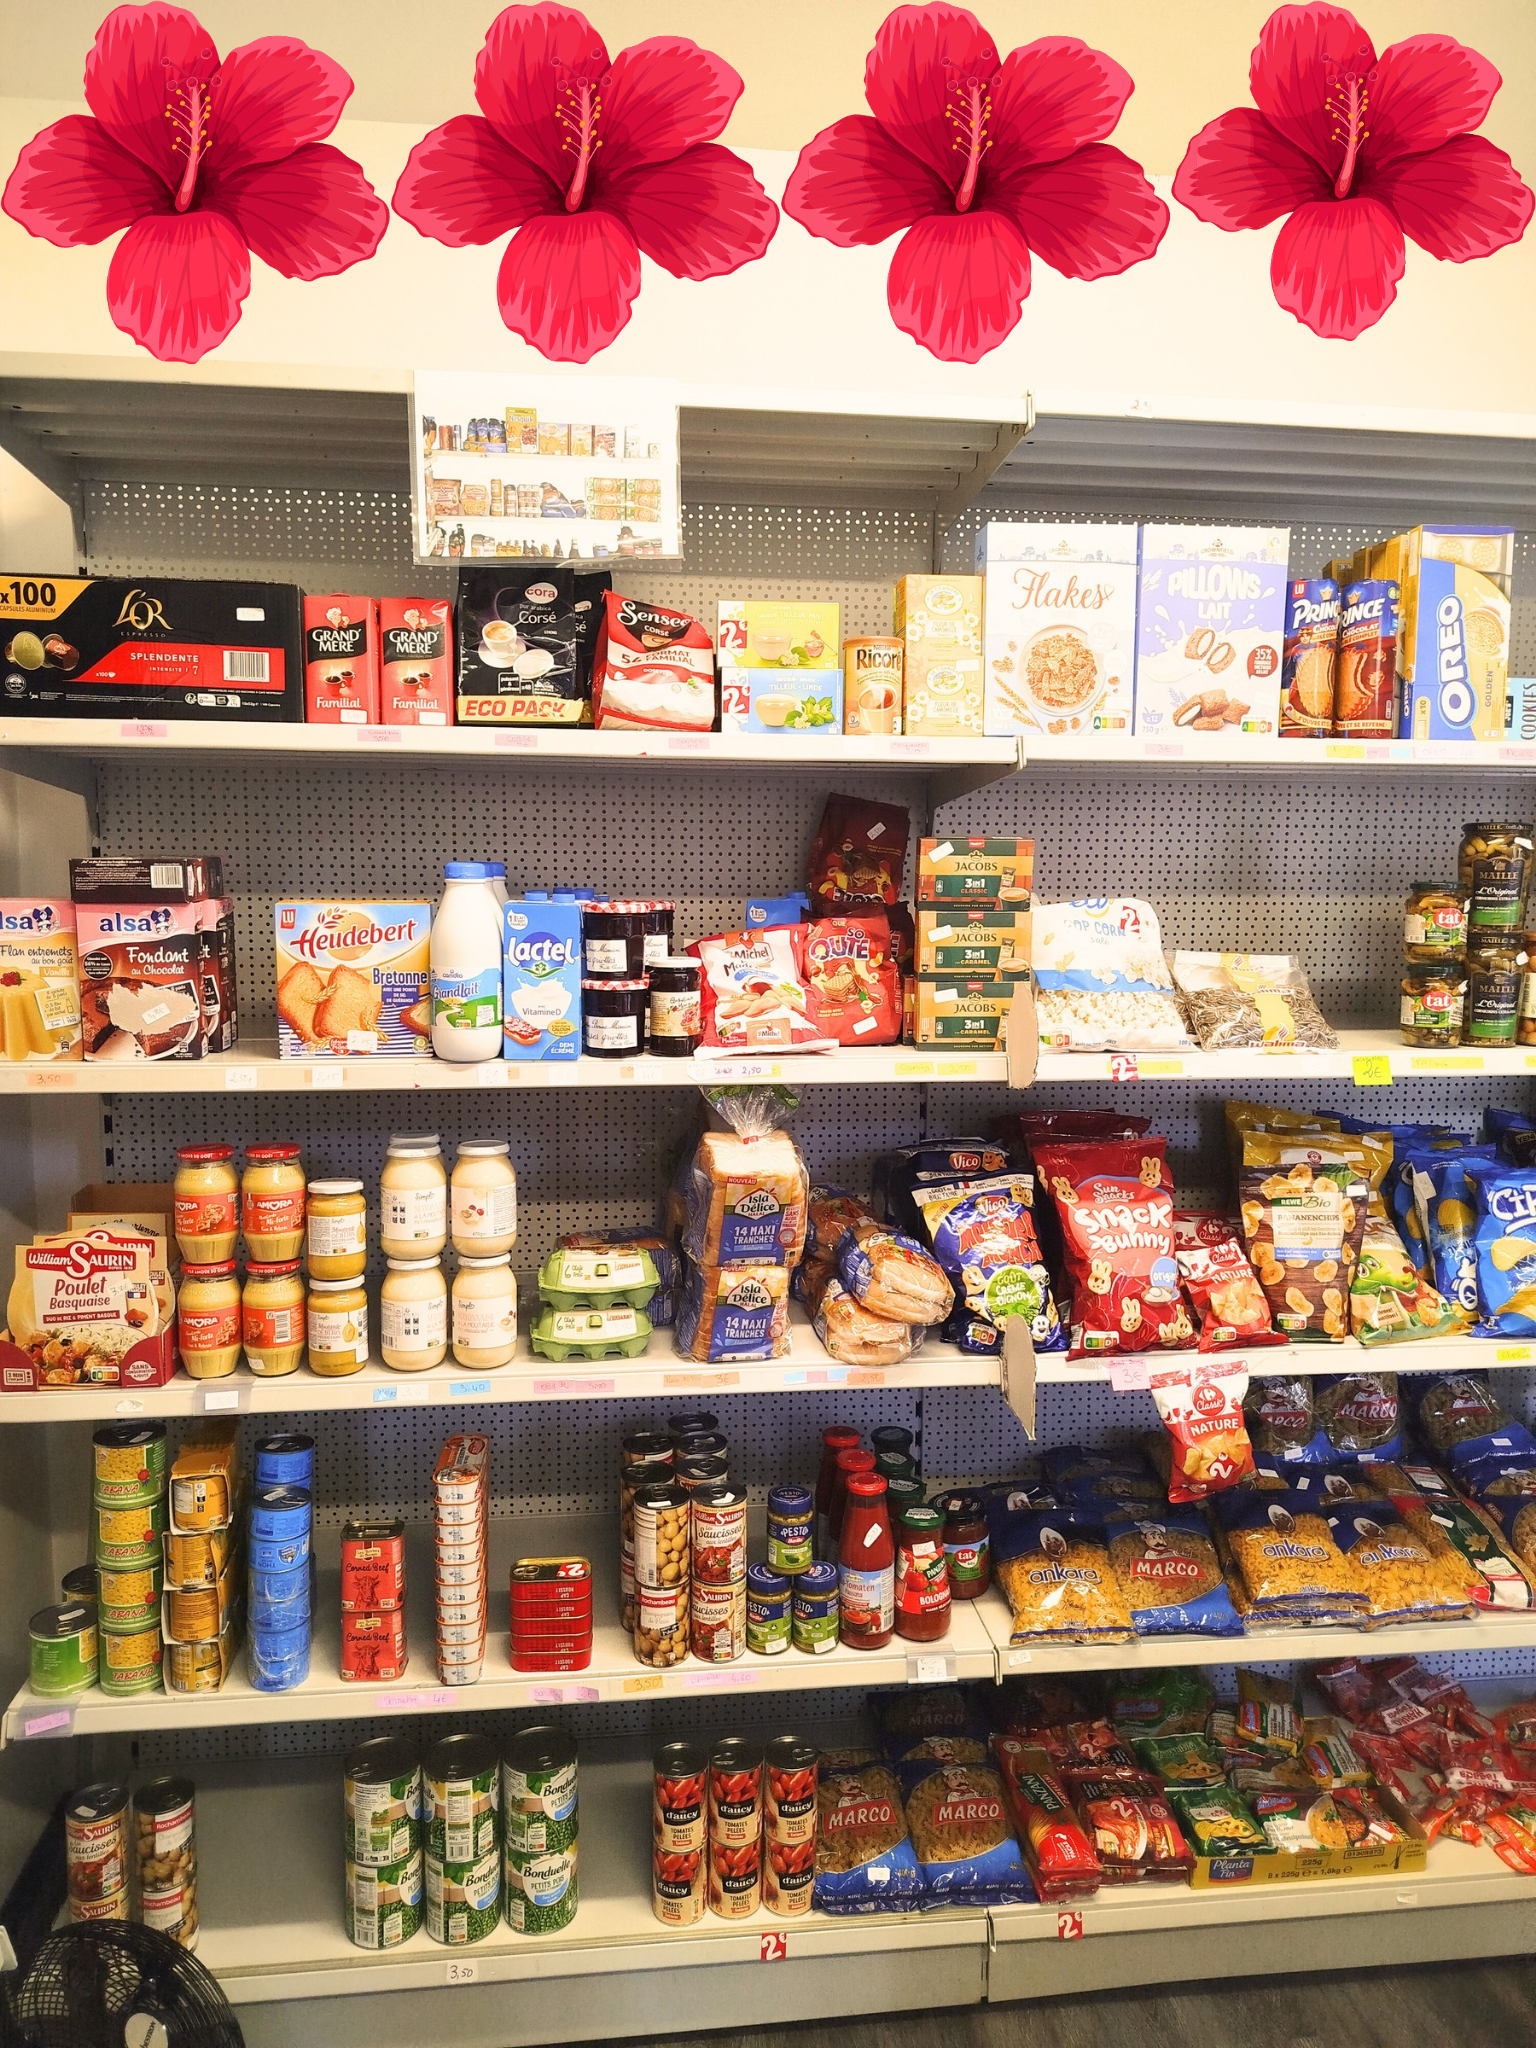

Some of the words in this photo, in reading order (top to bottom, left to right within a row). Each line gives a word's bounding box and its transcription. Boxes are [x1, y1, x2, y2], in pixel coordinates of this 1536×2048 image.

[1168, 564, 1262, 600] PILLOWS
[526, 587, 556, 599] cora
[1011, 567, 1104, 610] Flakes
[1295, 584, 1305, 595] LU
[616, 600, 692, 627] Senseo
[1198, 602, 1232, 620] LAIT
[519, 611, 557, 624] Corsé
[644, 625, 670, 637] CORSÉ
[130, 652, 199, 663] SPLENDENTE
[856, 649, 902, 670] Ricoré
[1254, 648, 1272, 660] 35%
[1439, 596, 1471, 723] OREO
[646, 654, 695, 667] FAMILIAL
[192, 665, 199, 675] 7
[802, 684, 824, 692] LINDE
[1485, 671, 1493, 707] GOLDEN
[316, 697, 361, 708] Familial
[393, 698, 439, 709] Familial
[464, 699, 506, 716] ECO
[511, 700, 566, 718] PACK
[954, 862, 998, 872] JACOBS
[1479, 871, 1519, 880] MAILLE
[100, 913, 152, 932] alsa
[283, 911, 294, 923] LU
[1437, 912, 1462, 925] tat
[847, 927, 865, 939] SO
[1095, 922, 1126, 936] CORN
[290, 920, 418, 958] Heudebert
[954, 933, 997, 943] JACOBS
[0, 945, 25, 957] Flan
[28, 946, 73, 957] entremets
[126, 947, 190, 963] Fondant
[508, 937, 575, 966] lactel
[734, 947, 770, 960] Michel
[43, 968, 70, 976] Vanille
[143, 964, 185, 975] Chocolat
[372, 967, 428, 984] Bretonne
[1479, 985, 1517, 994] MAILLE
[1425, 995, 1452, 1008] tat
[954, 1003, 997, 1013] JACOBS
[742, 1066, 761, 1075] 2,50
[1112, 1055, 1137, 1081] 2€
[1363, 1060, 1382, 1078] 2€
[36, 1075, 61, 1085] 3,50
[953, 1156, 979, 1169] Vico
[1093, 1183, 1120, 1195] Sun
[748, 1193, 769, 1204] Isla
[1093, 1190, 1135, 1204] Snacks
[1303, 1196, 1331, 1208] Bio
[256, 1199, 293, 1210] AMORA
[740, 1203, 776, 1213] Délice
[979, 1198, 1005, 1213] Vico
[1074, 1202, 1171, 1234] Snack
[734, 1226, 748, 1236] 14
[750, 1225, 776, 1236] MAXI
[734, 1235, 775, 1245] TRANCHES
[1097, 1231, 1170, 1255] Bunny
[28, 1253, 72, 1266] William
[66, 1243, 133, 1278] SAURIN
[1211, 1251, 1238, 1263] Classic
[997, 1272, 1022, 1284] GOÛT
[1210, 1267, 1254, 1284] NATURE
[54, 1277, 107, 1296] Poulet
[740, 1283, 761, 1295] Isla
[996, 1282, 1026, 1295] CRÈME
[50, 1295, 110, 1311] Basquaise
[732, 1293, 767, 1304] Délice
[996, 1291, 1032, 1306] OIGNON
[183, 1317, 218, 1328] AMORA
[726, 1317, 739, 1328] 14
[741, 1317, 767, 1328] MAXI
[725, 1328, 765, 1338] TRANCHES
[1123, 1368, 1141, 1384] 3€
[460, 1383, 486, 1393] 3,40
[1196, 1400, 1223, 1413] Classic
[1341, 1402, 1398, 1418] MARCO
[1190, 1418, 1239, 1436] NATURE
[101, 1483, 139, 1494] TABANA
[715, 1509, 744, 1525] SAURIN
[699, 1526, 742, 1538] Saucisses
[782, 1526, 808, 1537] PESTO
[105, 1545, 144, 1556] TABANA
[958, 1550, 973, 1560] tat
[1263, 1540, 1325, 1560] ankara
[1360, 1545, 1423, 1565] ankara
[346, 1562, 371, 1572] Corned
[372, 1562, 389, 1573] Beef
[1137, 1560, 1198, 1577] MARCO
[1029, 1563, 1099, 1585] ankara
[700, 1590, 732, 1602] SAURIN
[844, 1589, 863, 1598] Passata
[107, 1607, 146, 1618] TABANA
[346, 1632, 372, 1642] Corned
[373, 1632, 389, 1643] Beef
[113, 1667, 154, 1680] TABANA
[634, 1678, 660, 1690] 3,50
[1022, 1775, 1060, 1810] PANZANI
[720, 1804, 753, 1815] d'aucy
[781, 1801, 812, 1812] d'aucy
[938, 1803, 999, 1820] MARCO
[156, 1810, 192, 1829] Rochambeau
[666, 1810, 699, 1821] d'aucy
[829, 1807, 890, 1829] MARCO
[786, 1818, 808, 1826] TOMATES
[788, 1824, 806, 1832] PELÉES
[84, 1820, 121, 1842] SAURIN
[671, 1827, 694, 1835] TOMATES
[672, 1832, 692, 1840] PELÉES
[727, 1826, 745, 1834] PELÉES
[69, 1835, 117, 1853] Saucisses
[1212, 1860, 1250, 1871] Planta
[1302, 1858, 1322, 1866] 225g
[523, 1859, 570, 1880] Bonduelle
[1220, 1868, 1236, 1878] Fin
[1281, 1870, 1300, 1879] 225g
[531, 1881, 550, 1890] PETITS
[552, 1875, 564, 1885] POIS
[725, 1877, 758, 1889] d'aucy
[782, 1874, 812, 1884] d'aucy
[658, 1883, 688, 1896] d'aucy
[787, 1890, 809, 1898] TOMATES
[144, 1896, 181, 1908] Rochambeau
[729, 1893, 752, 1902] TOMATES
[732, 1899, 750, 1907] PELÉES
[789, 1896, 806, 1904] PELÉES
[660, 1899, 683, 1909] TOMATES
[662, 1905, 681, 1913] PELÉES
[80, 1902, 116, 1919] SAURIN
[1058, 1912, 1083, 1938] 2€
[762, 1933, 787, 1960] 2€
[450, 1966, 473, 1979] 3,50
